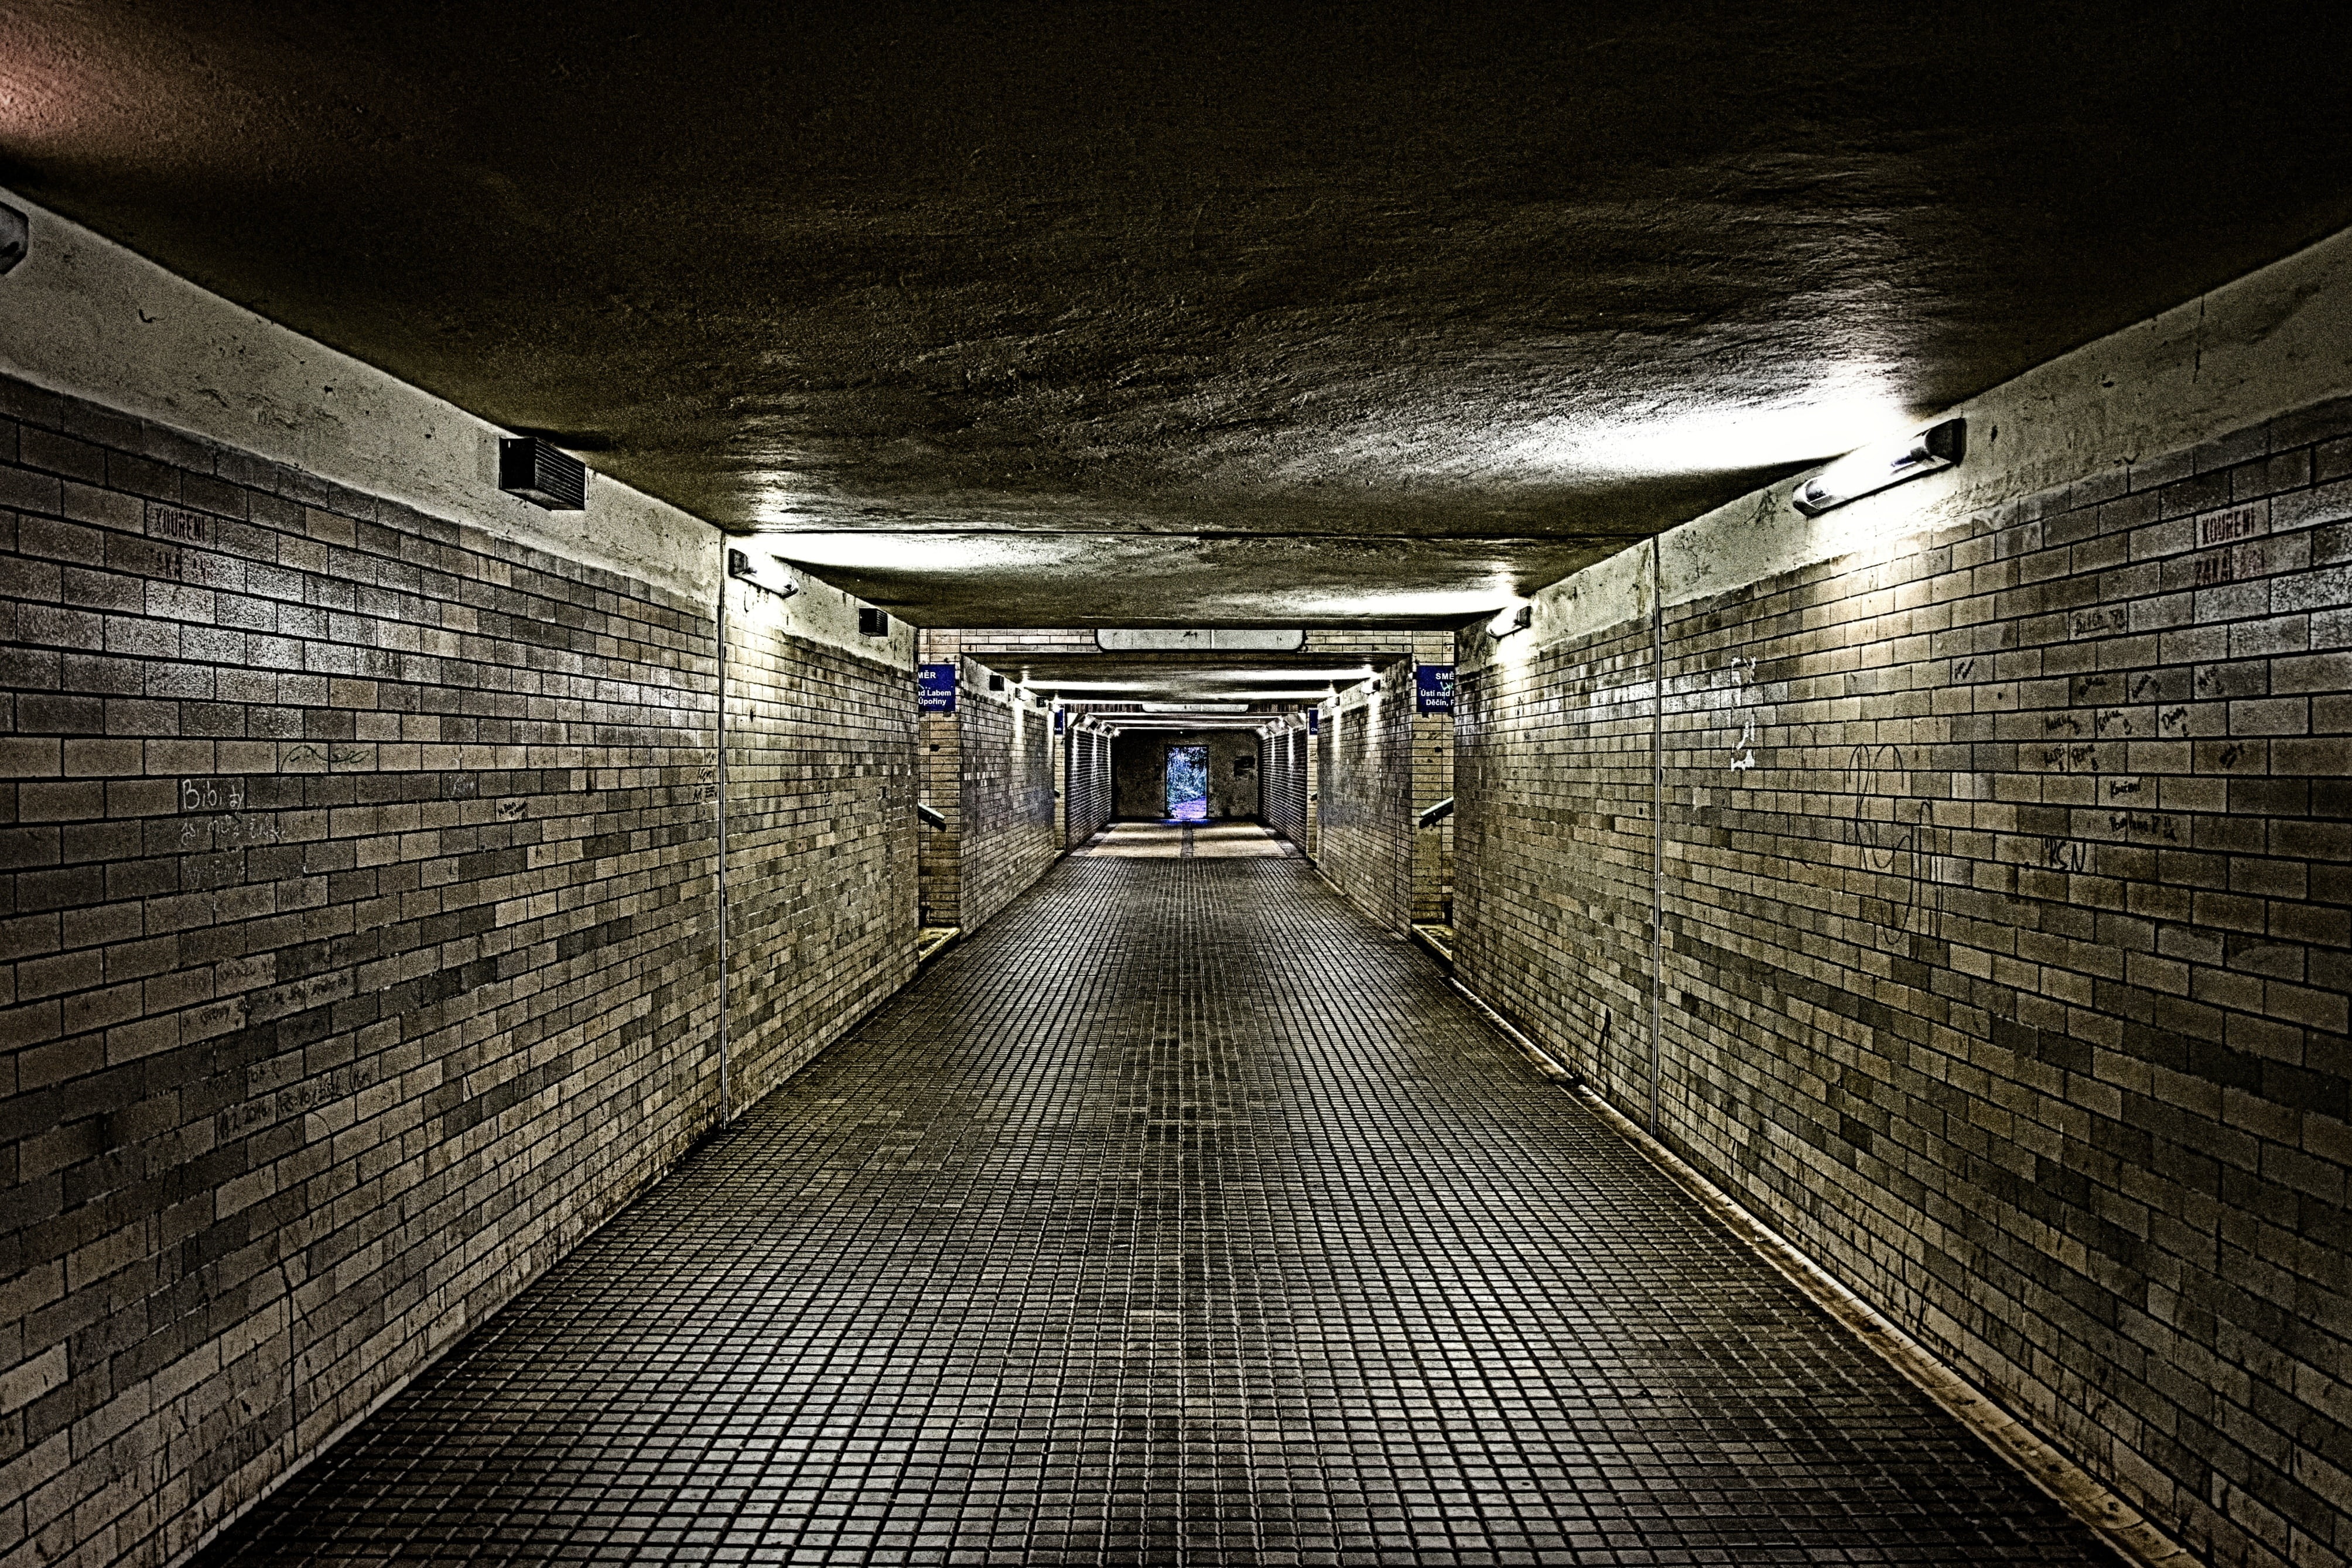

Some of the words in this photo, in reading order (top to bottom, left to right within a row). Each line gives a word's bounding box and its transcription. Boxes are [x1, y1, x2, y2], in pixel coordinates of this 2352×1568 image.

[1420, 689, 1435, 697] Ústí
[918, 697, 946, 706] Úpořiny
[1426, 699, 1449, 707] Děčín,
